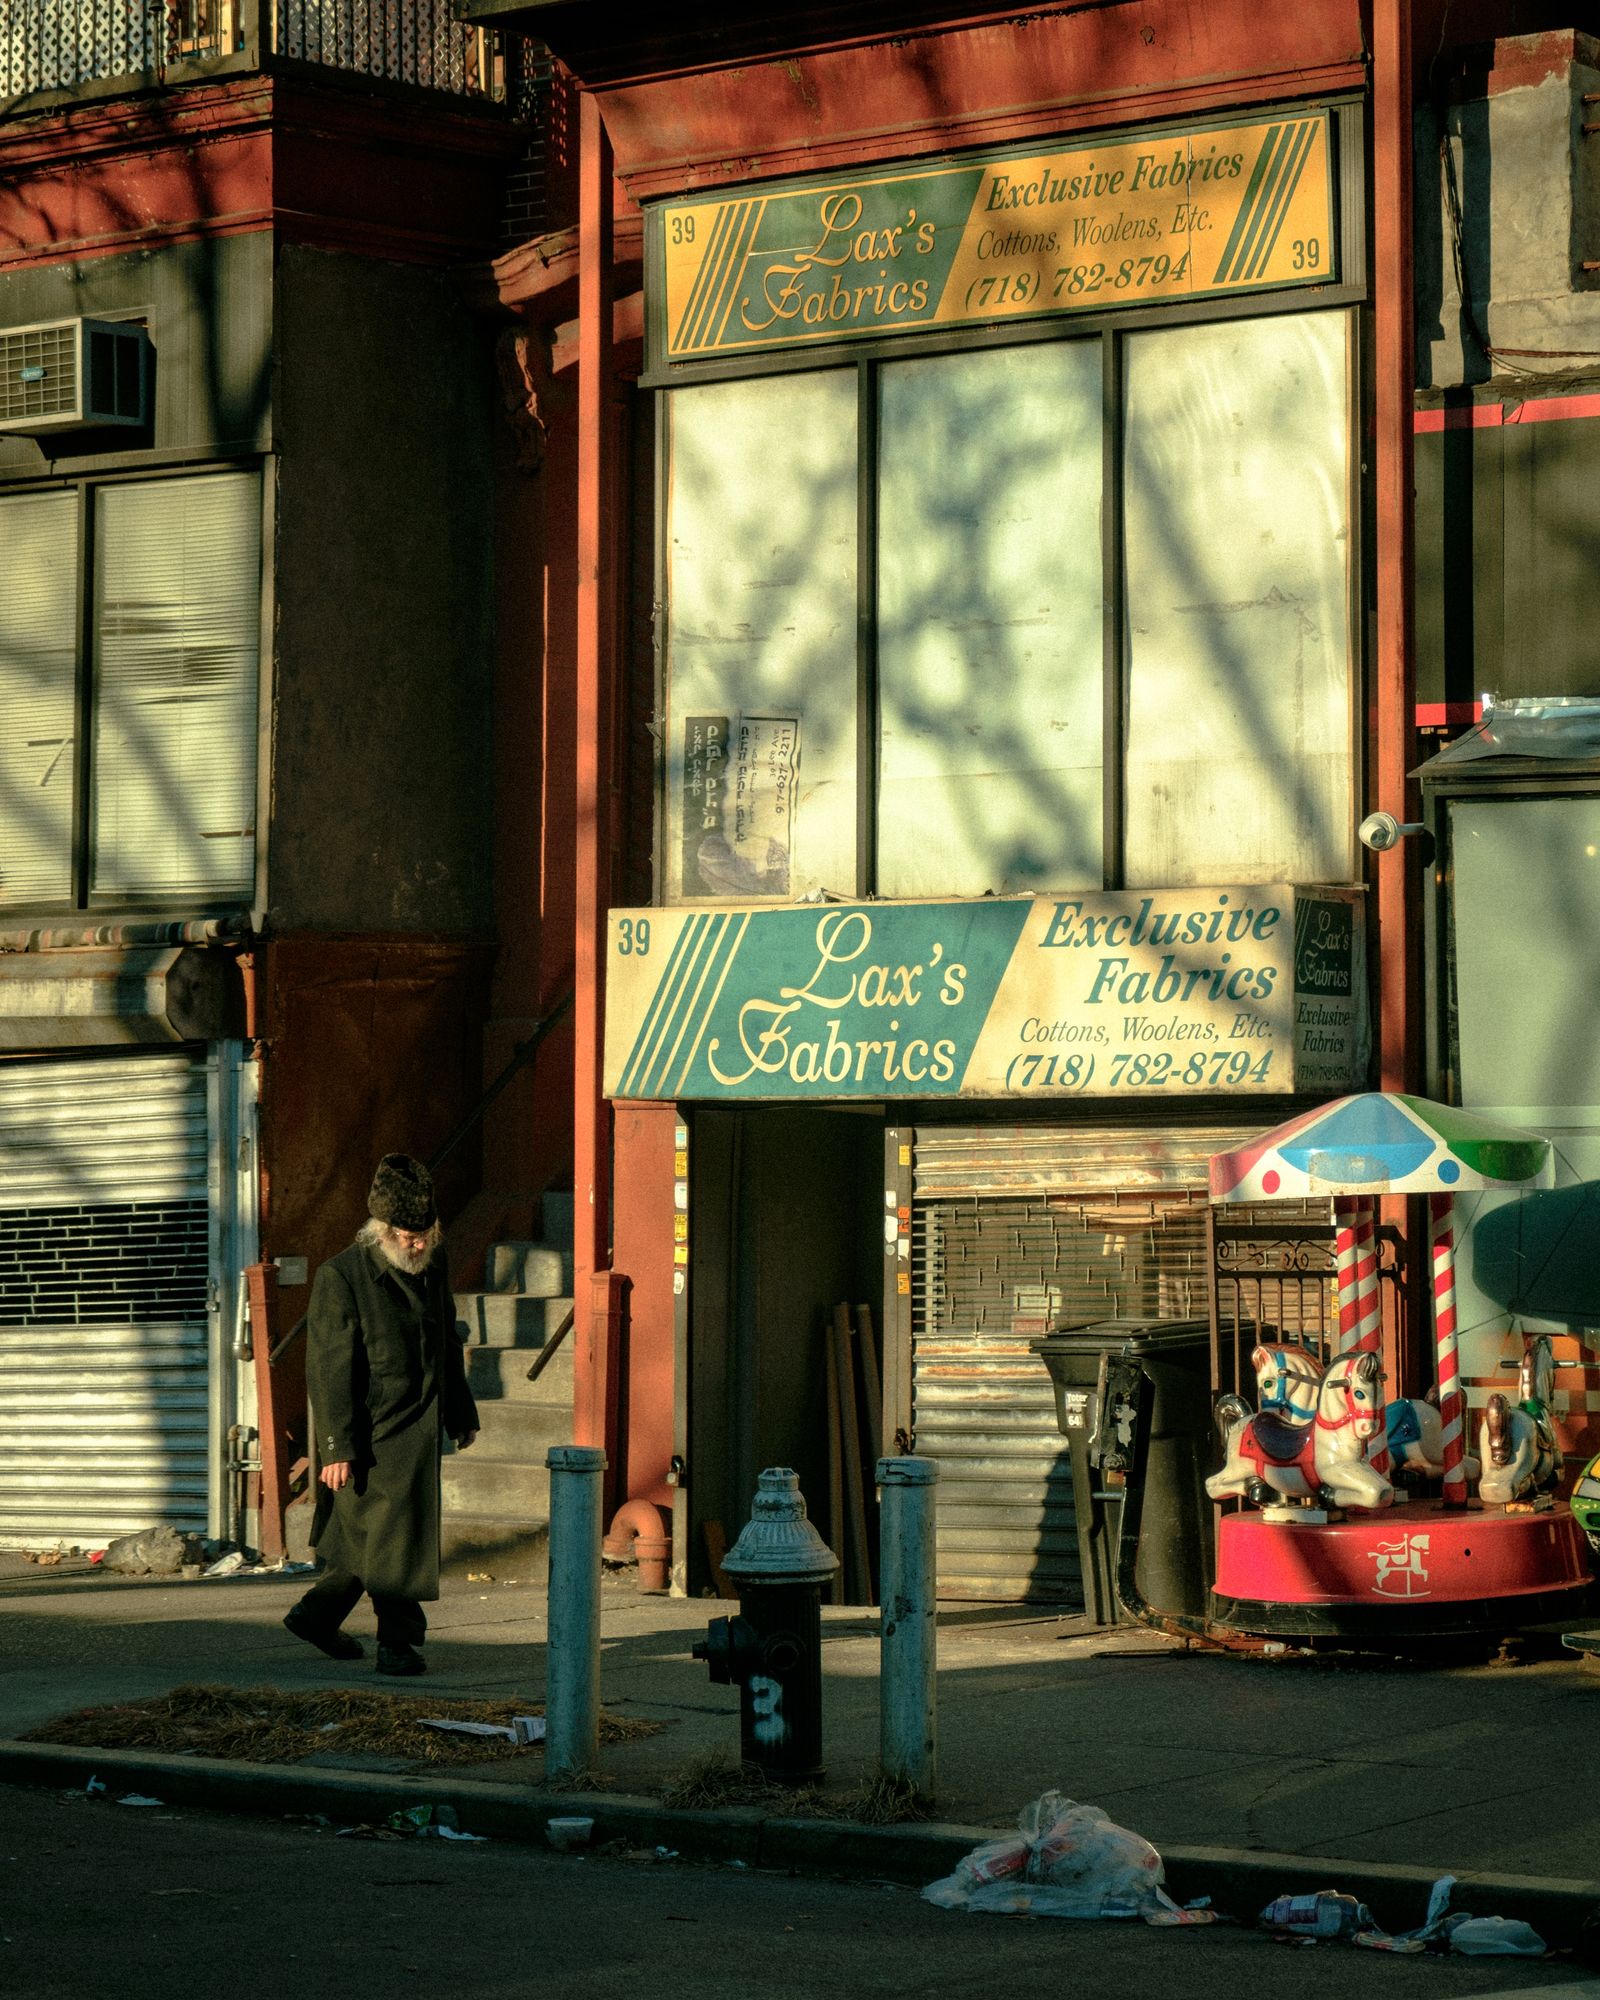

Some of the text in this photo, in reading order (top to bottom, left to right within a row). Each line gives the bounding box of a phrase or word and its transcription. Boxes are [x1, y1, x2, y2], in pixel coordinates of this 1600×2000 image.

[984, 145, 1245, 213] Exclusive Fabrics
[671, 214, 696, 245] 39
[794, 193, 936, 267] Lax's
[977, 202, 1213, 260] Cottons, Woolens, Etc.
[1292, 237, 1320, 270] 39
[741, 263, 929, 331] Fabrics
[965, 249, 1191, 312] (718) 782-8794
[705, 725, 722, 771] סופר
[778, 728, 791, 757] 2211
[618, 918, 650, 956] 39
[1038, 894, 1281, 948] Exclusive
[1310, 910, 1350, 951] Lax's
[780, 911, 967, 1009] Lax's
[1084, 952, 1278, 1005] Fabrics
[1297, 950, 1349, 988] Fabrics
[1020, 1013, 1273, 1046] Cottons, Woolens, Etc.
[1297, 1002, 1350, 1027] Exclusive
[707, 998, 956, 1086] Fabrics
[1302, 1030, 1345, 1053] Fabrics
[1005, 1050, 1274, 1090] (718) 782-8794
